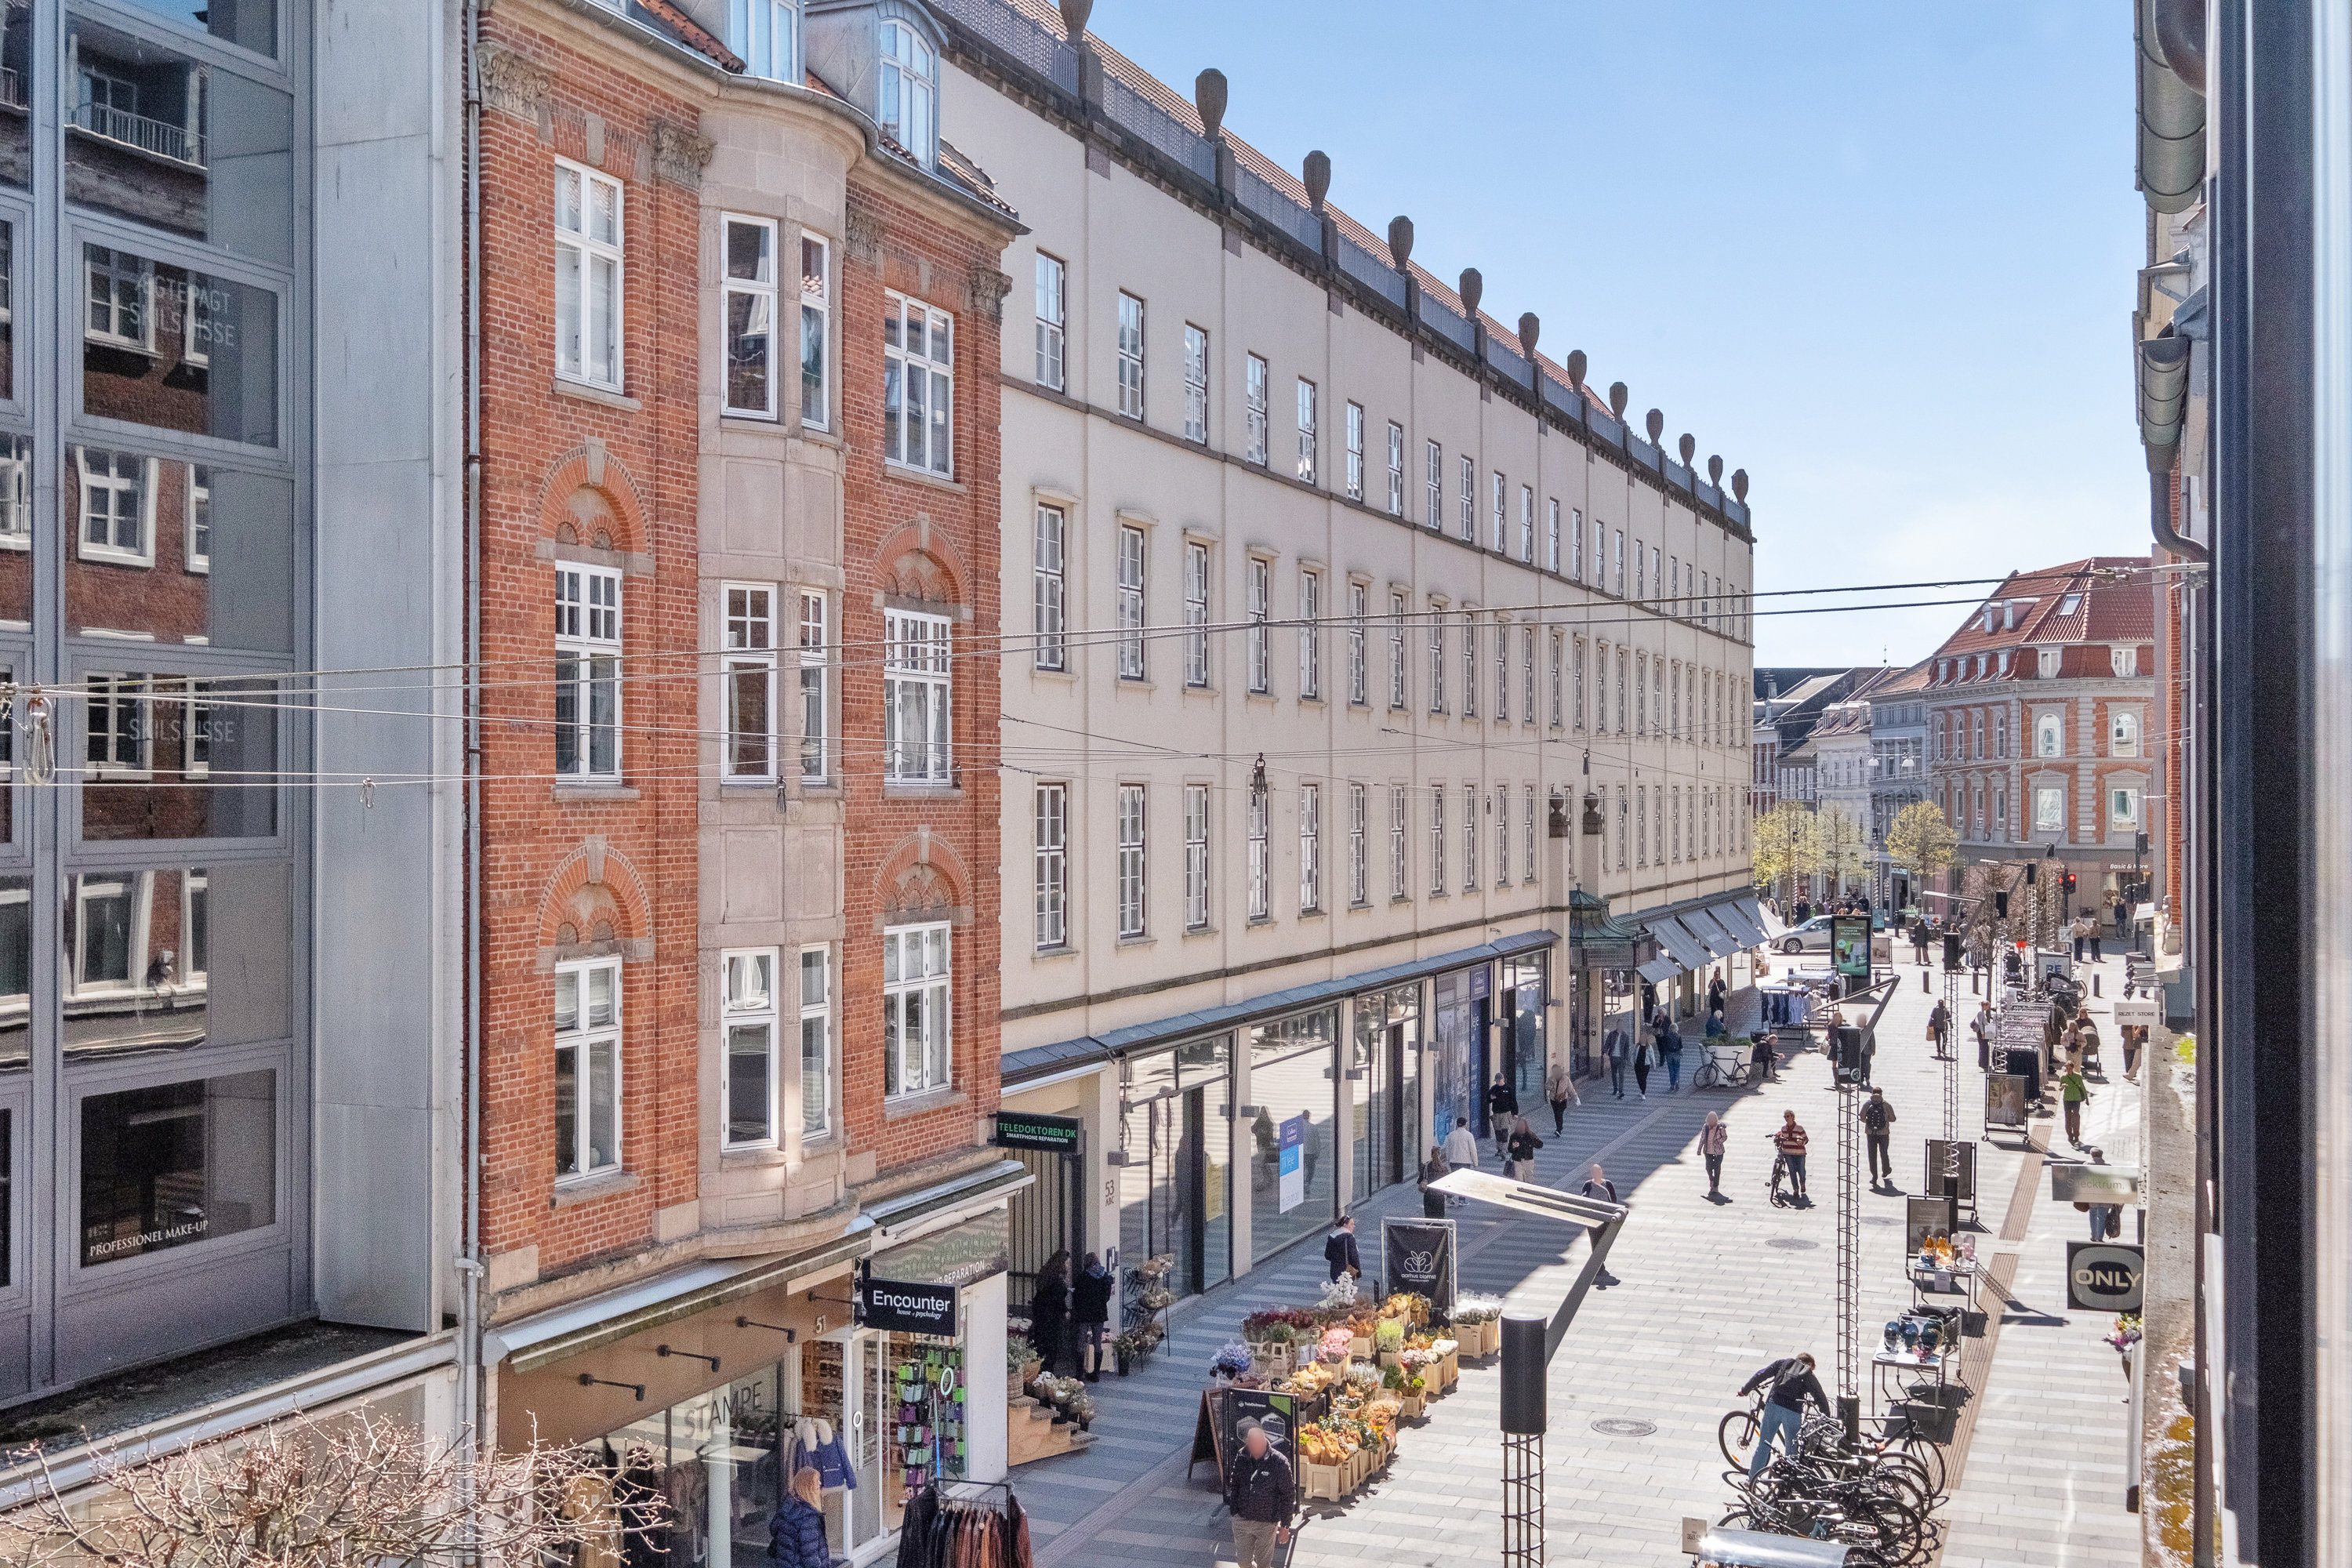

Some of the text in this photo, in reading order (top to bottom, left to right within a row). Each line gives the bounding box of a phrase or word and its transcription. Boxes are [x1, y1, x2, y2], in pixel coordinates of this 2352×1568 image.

[129, 301, 235, 346] SILSISSE
[129, 717, 234, 742] SILSISSE
[1006, 1132, 1038, 1141] SMARTPHONE
[1105, 1179, 1115, 1198] 53
[2066, 1178, 2125, 1190] Secktrum.
[1105, 1196, 1115, 1207] ABC
[89, 1219, 209, 1256] PROFESSIONEL MAKE-UP
[944, 1259, 985, 1284] REPARATION
[2075, 1269, 2141, 1287] ONLY
[873, 1290, 950, 1312] Encounter
[815, 1315, 826, 1334] 51
[915, 1311, 941, 1319] psychology
[684, 1381, 762, 1438] STAMPE
